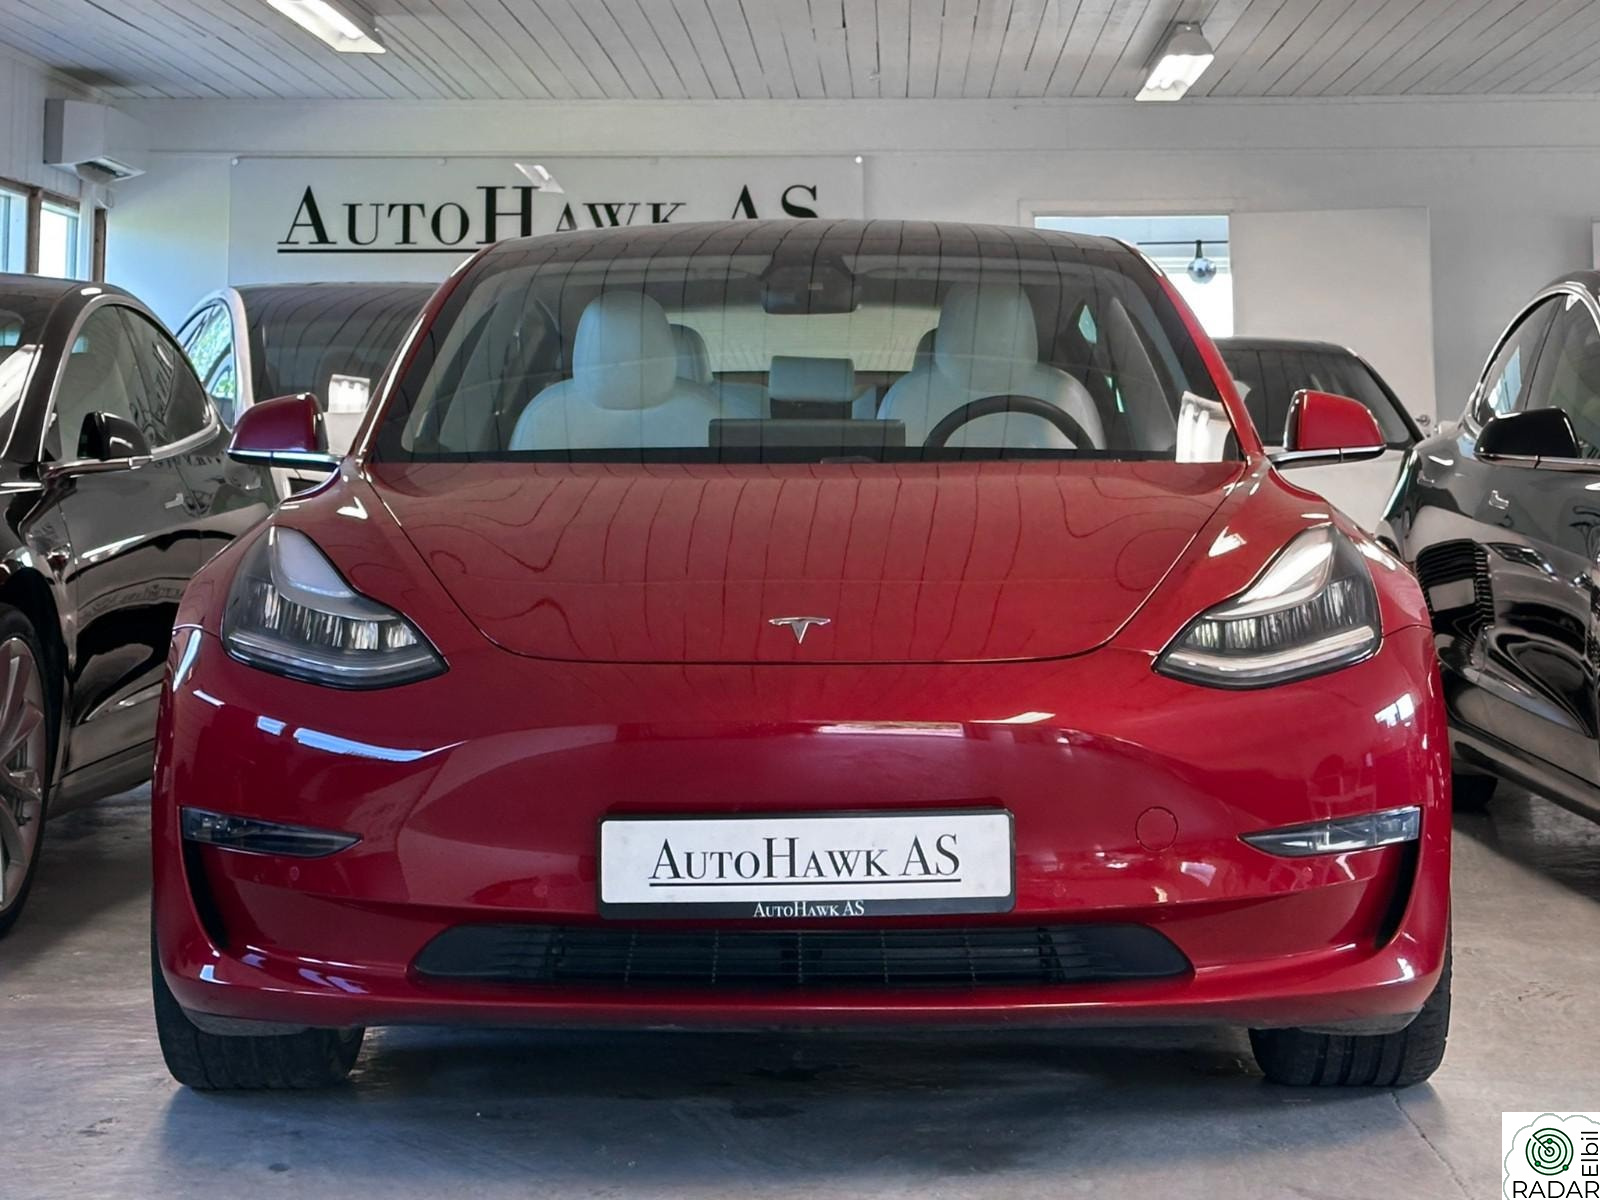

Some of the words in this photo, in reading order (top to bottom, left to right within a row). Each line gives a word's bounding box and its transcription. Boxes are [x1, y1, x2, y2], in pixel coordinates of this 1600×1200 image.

[731, 184, 818, 220] AS
[898, 833, 960, 877] AS
[842, 900, 865, 917] AS
